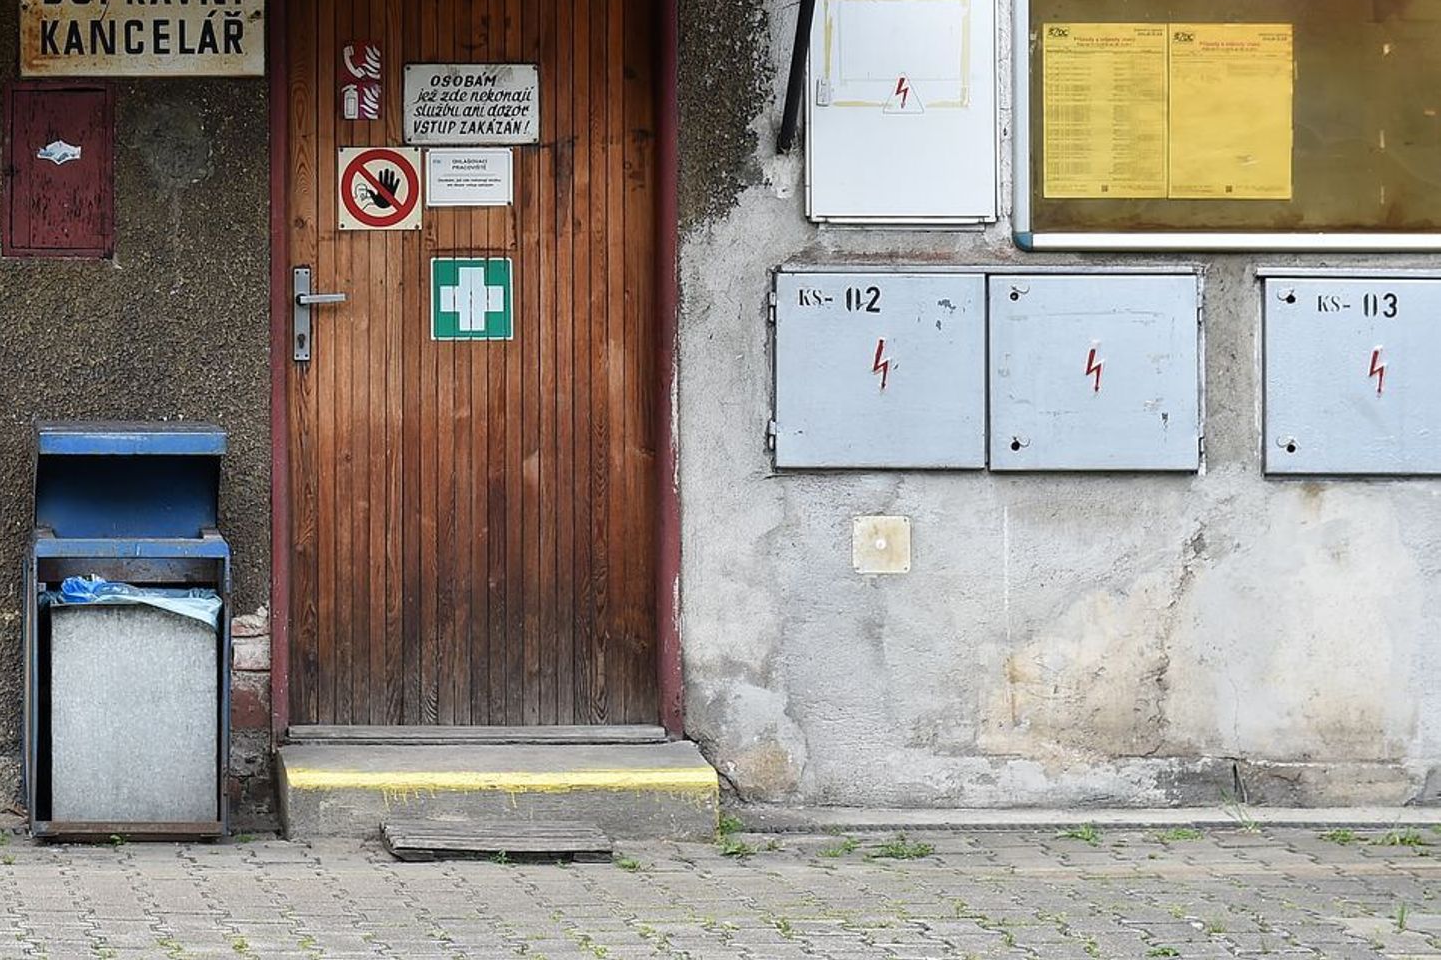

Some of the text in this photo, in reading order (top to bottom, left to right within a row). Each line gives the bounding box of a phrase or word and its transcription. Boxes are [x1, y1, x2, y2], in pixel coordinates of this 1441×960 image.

[40, 9, 244, 56] KANCELÁŘ
[430, 72, 497, 87] OSOBÁM
[412, 88, 438, 104] jež
[439, 89, 468, 103] zde
[462, 104, 485, 118] ani
[487, 103, 530, 118] dozor
[413, 120, 457, 135] VSTUP
